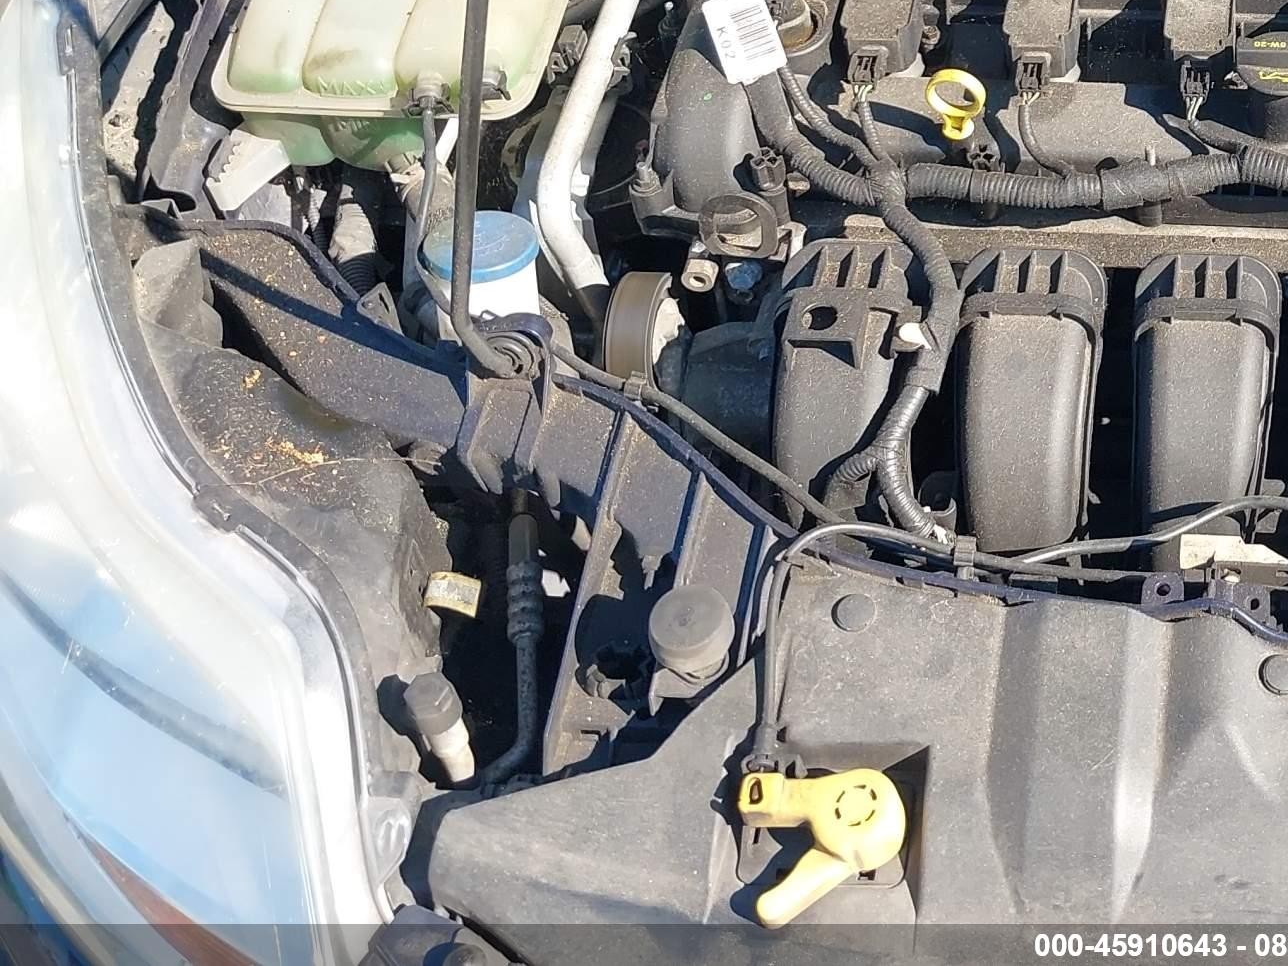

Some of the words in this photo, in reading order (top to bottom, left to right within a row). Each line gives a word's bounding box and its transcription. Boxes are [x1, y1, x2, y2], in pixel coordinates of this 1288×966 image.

[717, 26, 736, 59] K02
[1254, 41, 1287, 49] 0W-20
[317, 76, 377, 97] MAX
